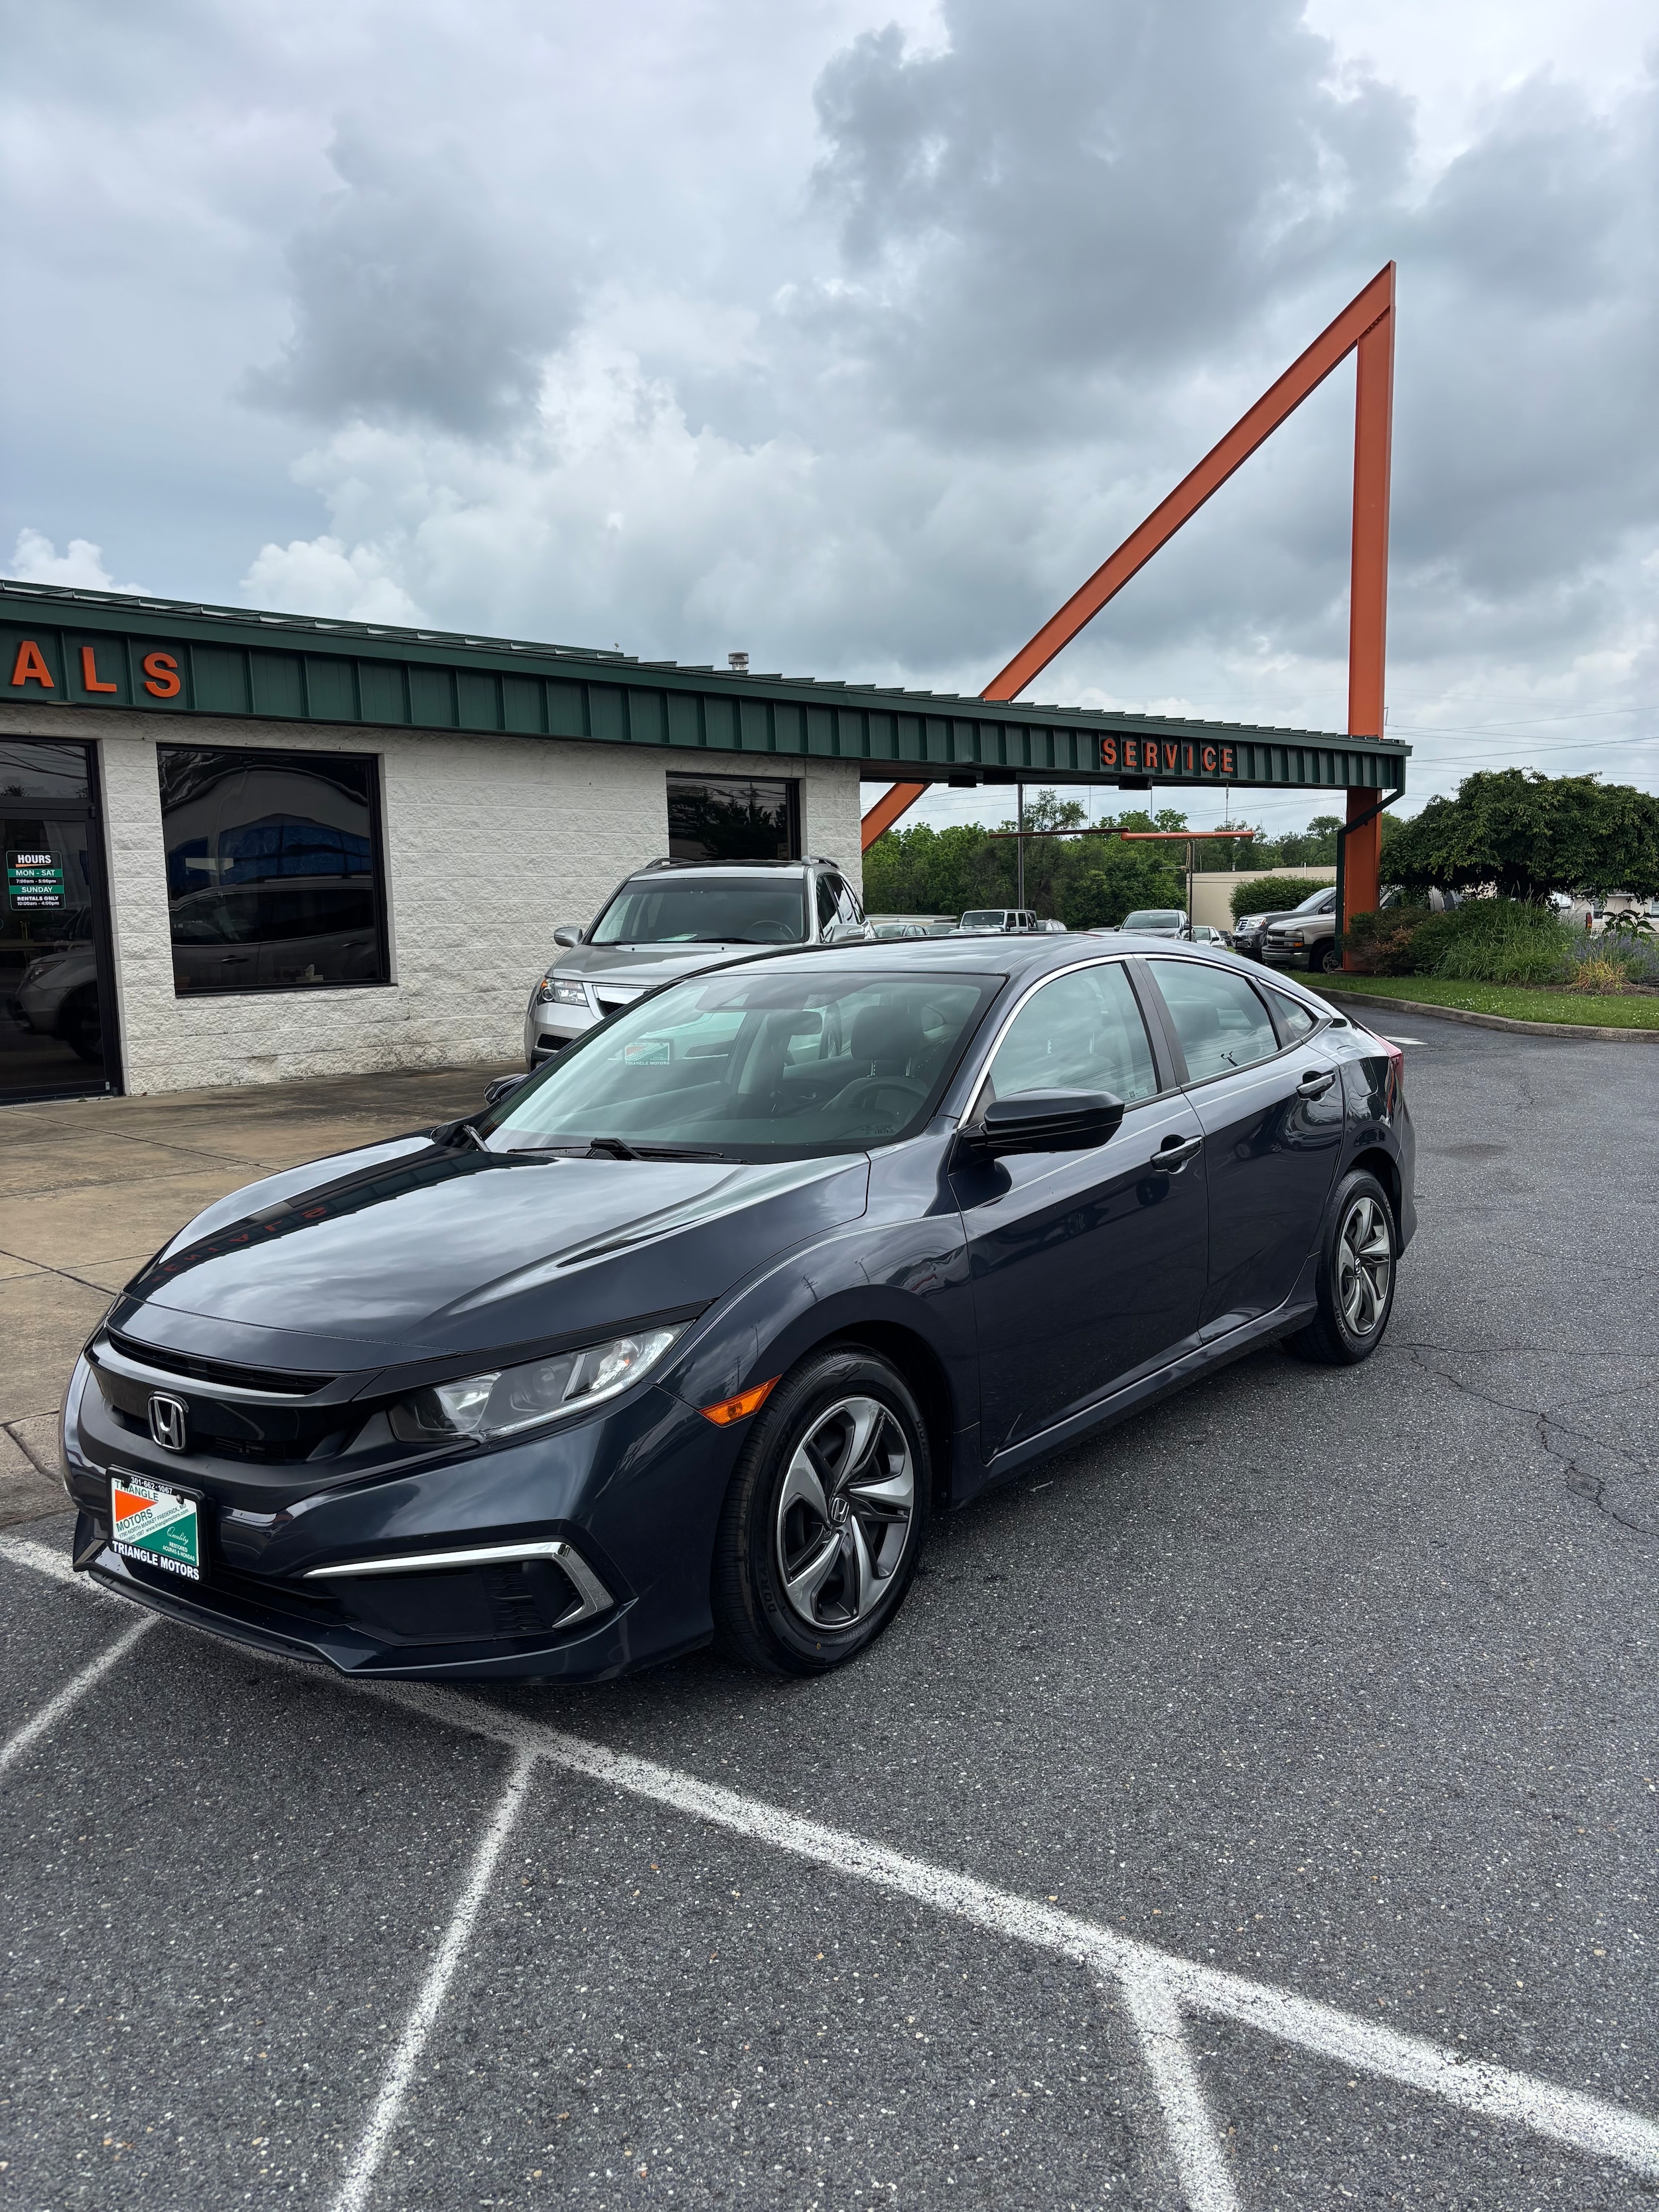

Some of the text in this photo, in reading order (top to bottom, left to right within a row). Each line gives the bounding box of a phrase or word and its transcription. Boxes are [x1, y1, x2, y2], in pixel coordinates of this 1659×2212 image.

[12, 640, 180, 698] ALS
[1103, 738, 1233, 773] SERVICE
[17, 855, 51, 863] HOURS
[116, 1509, 153, 1532] MOTORS
[127, 1526, 141, 1534] NORTH
[141, 1517, 157, 1528] MARKET
[167, 1526, 189, 1546] Quality
[163, 1545, 177, 1556] ACURAS
[180, 1550, 195, 1562] HONDAS
[169, 1542, 188, 1553] RESTORED
[112, 1540, 200, 1581] TRIANGLE MOTORS
